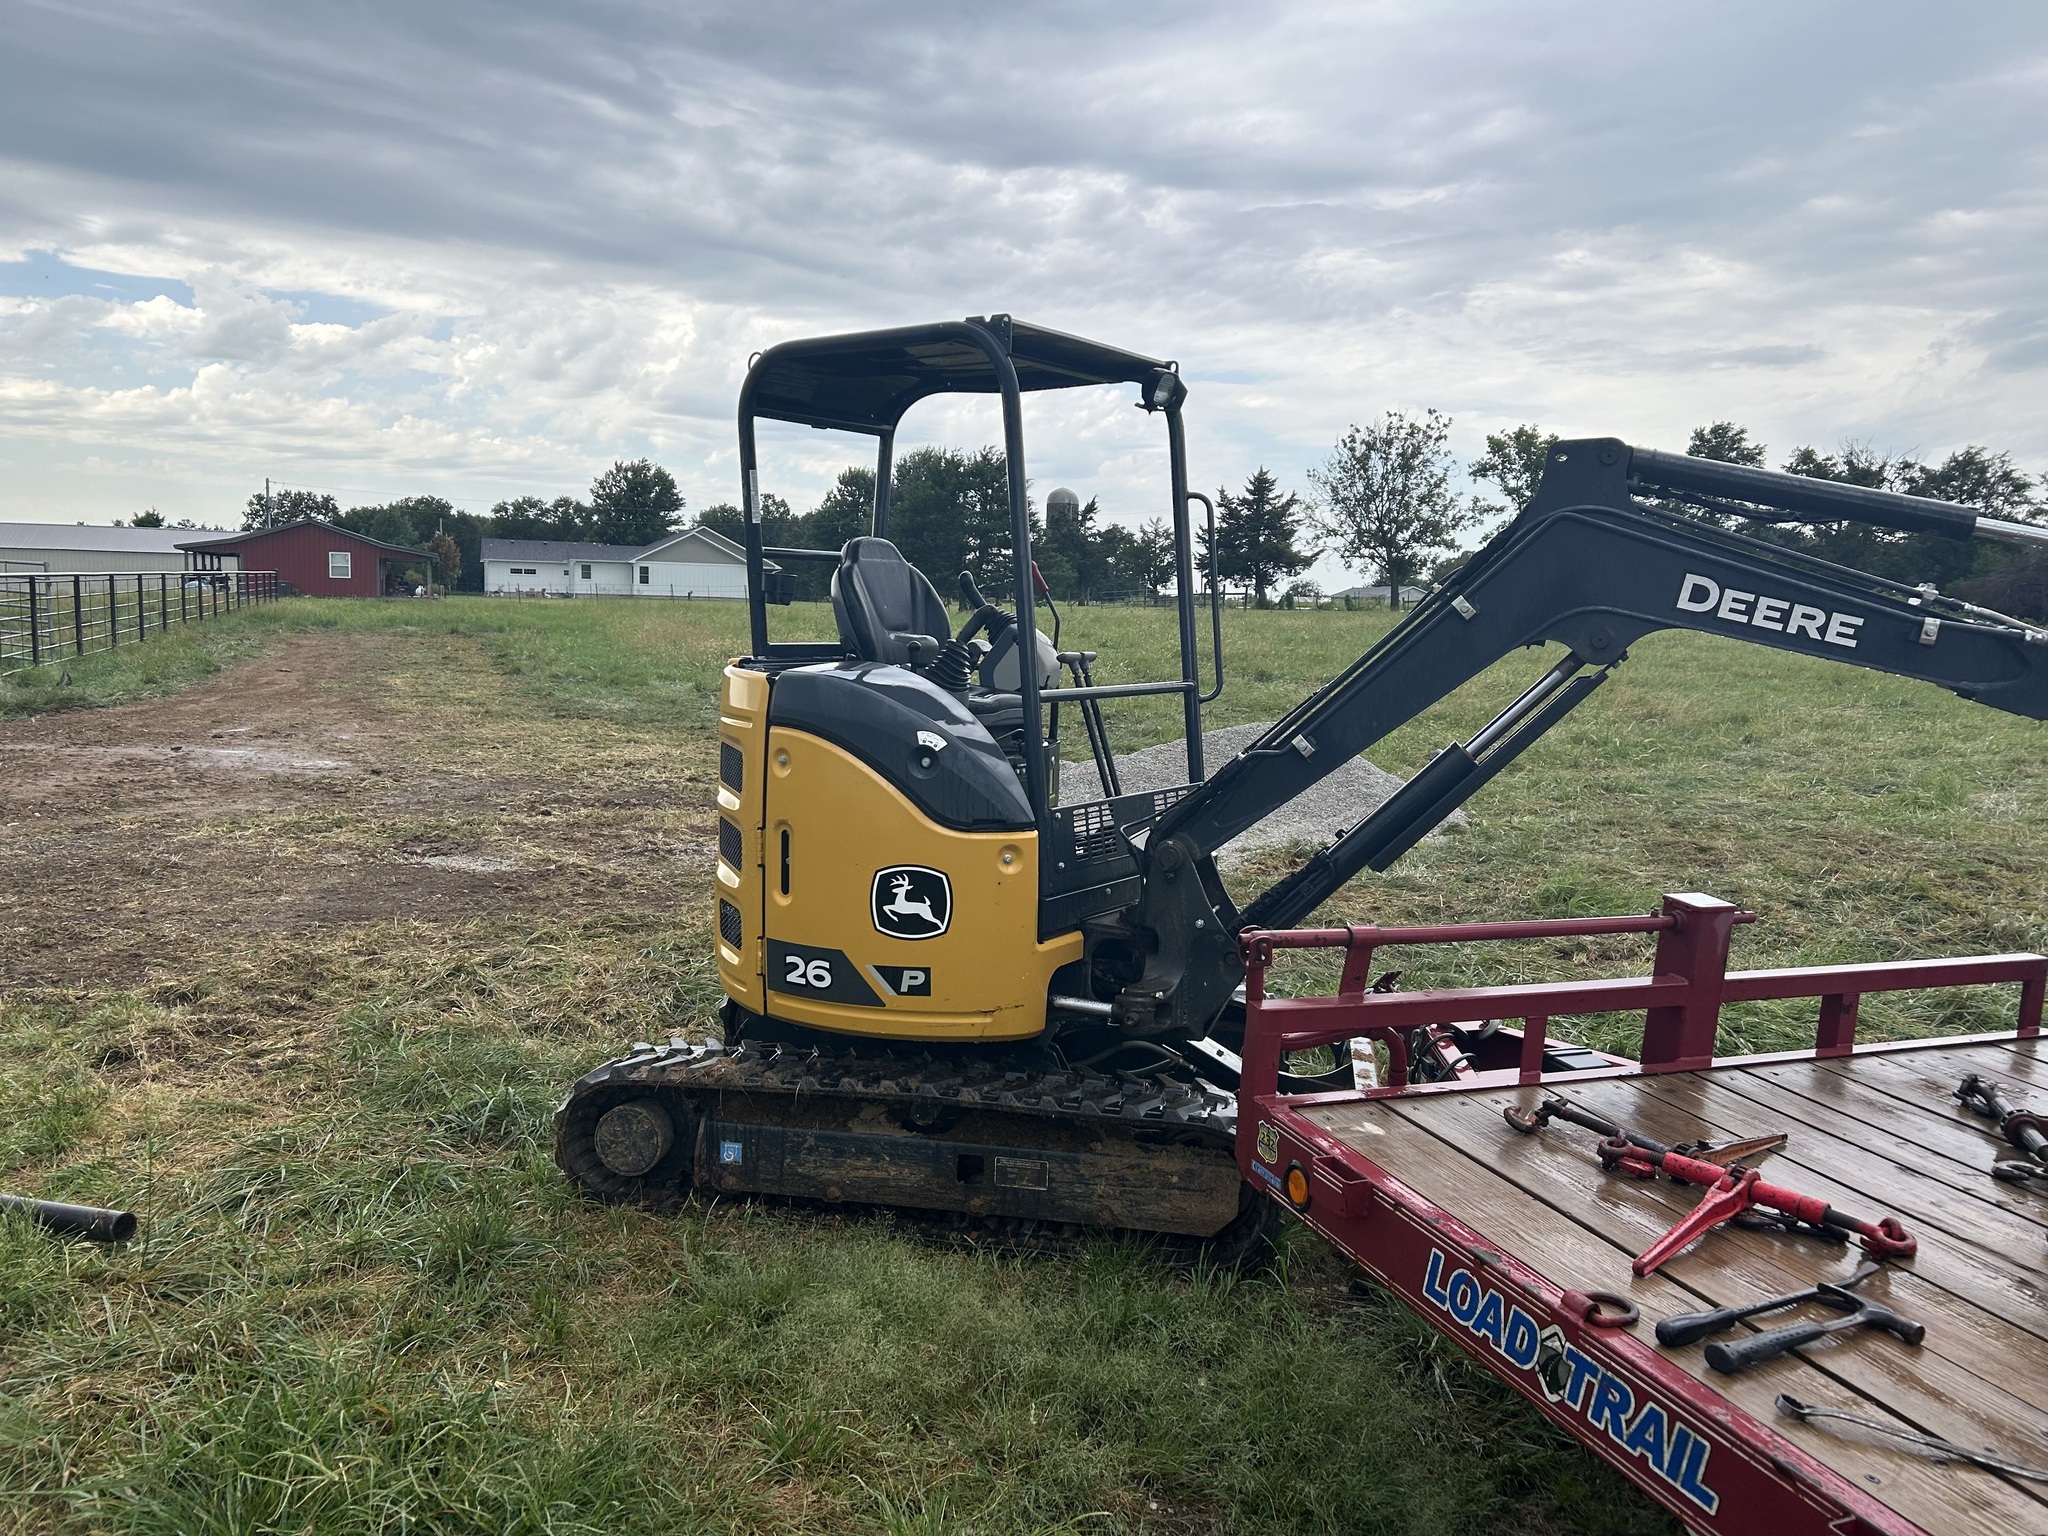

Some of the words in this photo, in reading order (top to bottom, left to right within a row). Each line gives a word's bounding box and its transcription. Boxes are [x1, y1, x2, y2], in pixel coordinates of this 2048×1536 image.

[1676, 573, 1865, 648] DEERE
[785, 955, 832, 988] 26
[900, 970, 926, 993] P
[1260, 1131, 1275, 1149] 232
[1422, 1247, 1541, 1370] LOAD
[1562, 1341, 1720, 1516] TRAIL
